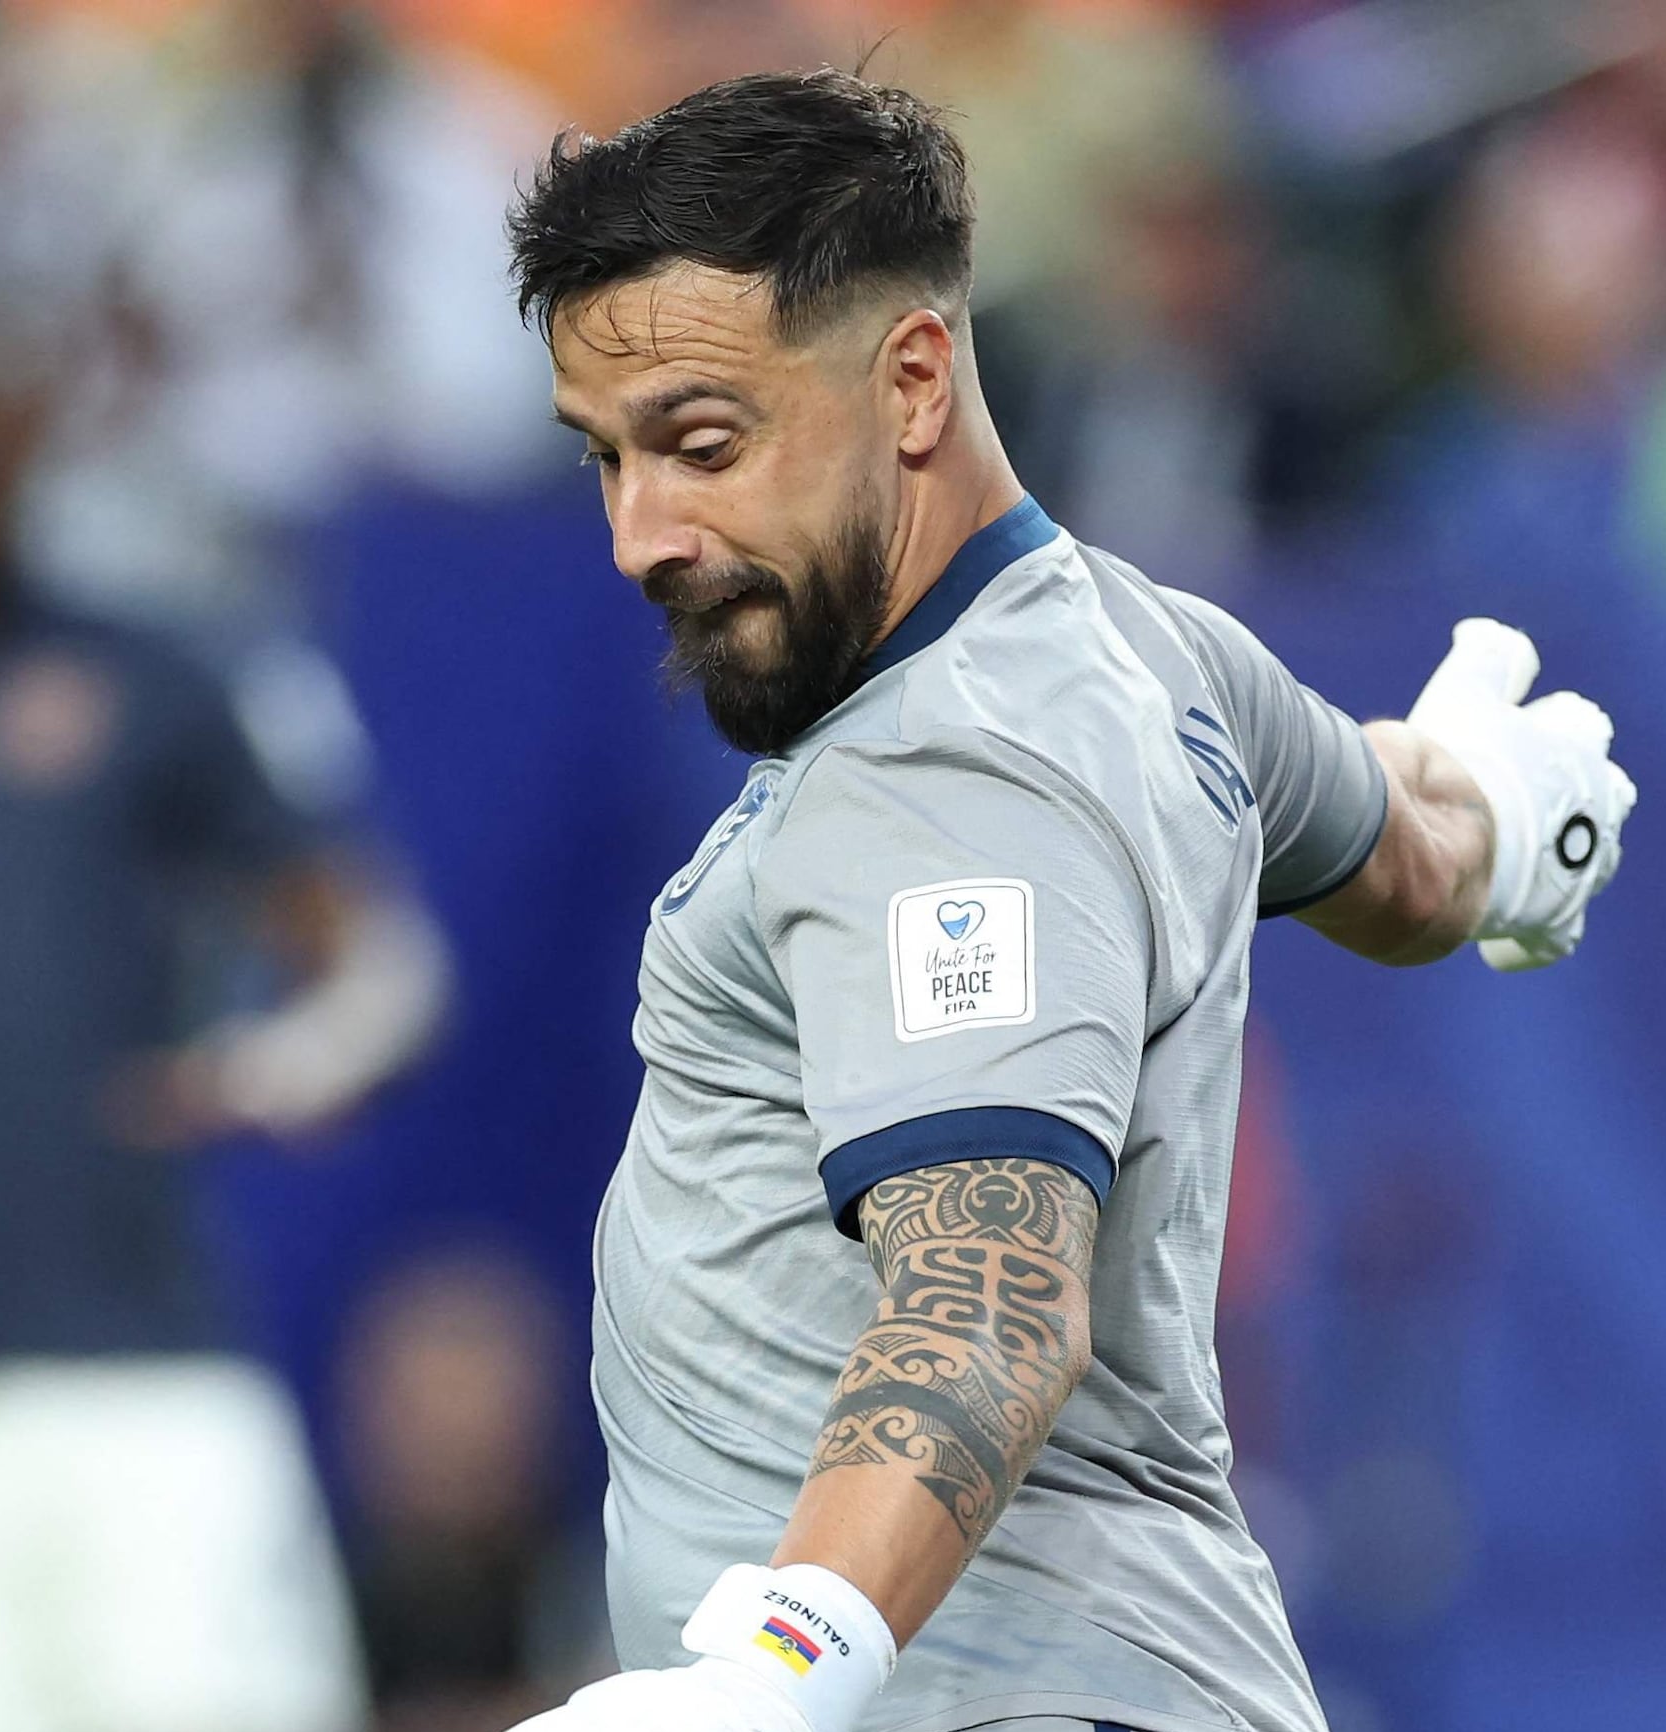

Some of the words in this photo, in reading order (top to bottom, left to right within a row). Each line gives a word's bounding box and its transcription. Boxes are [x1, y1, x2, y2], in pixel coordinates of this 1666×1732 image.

[925, 947, 968, 974] Unite
[971, 943, 997, 968] For
[932, 970, 993, 1001] PEACE
[945, 1000, 977, 1015] FIFA
